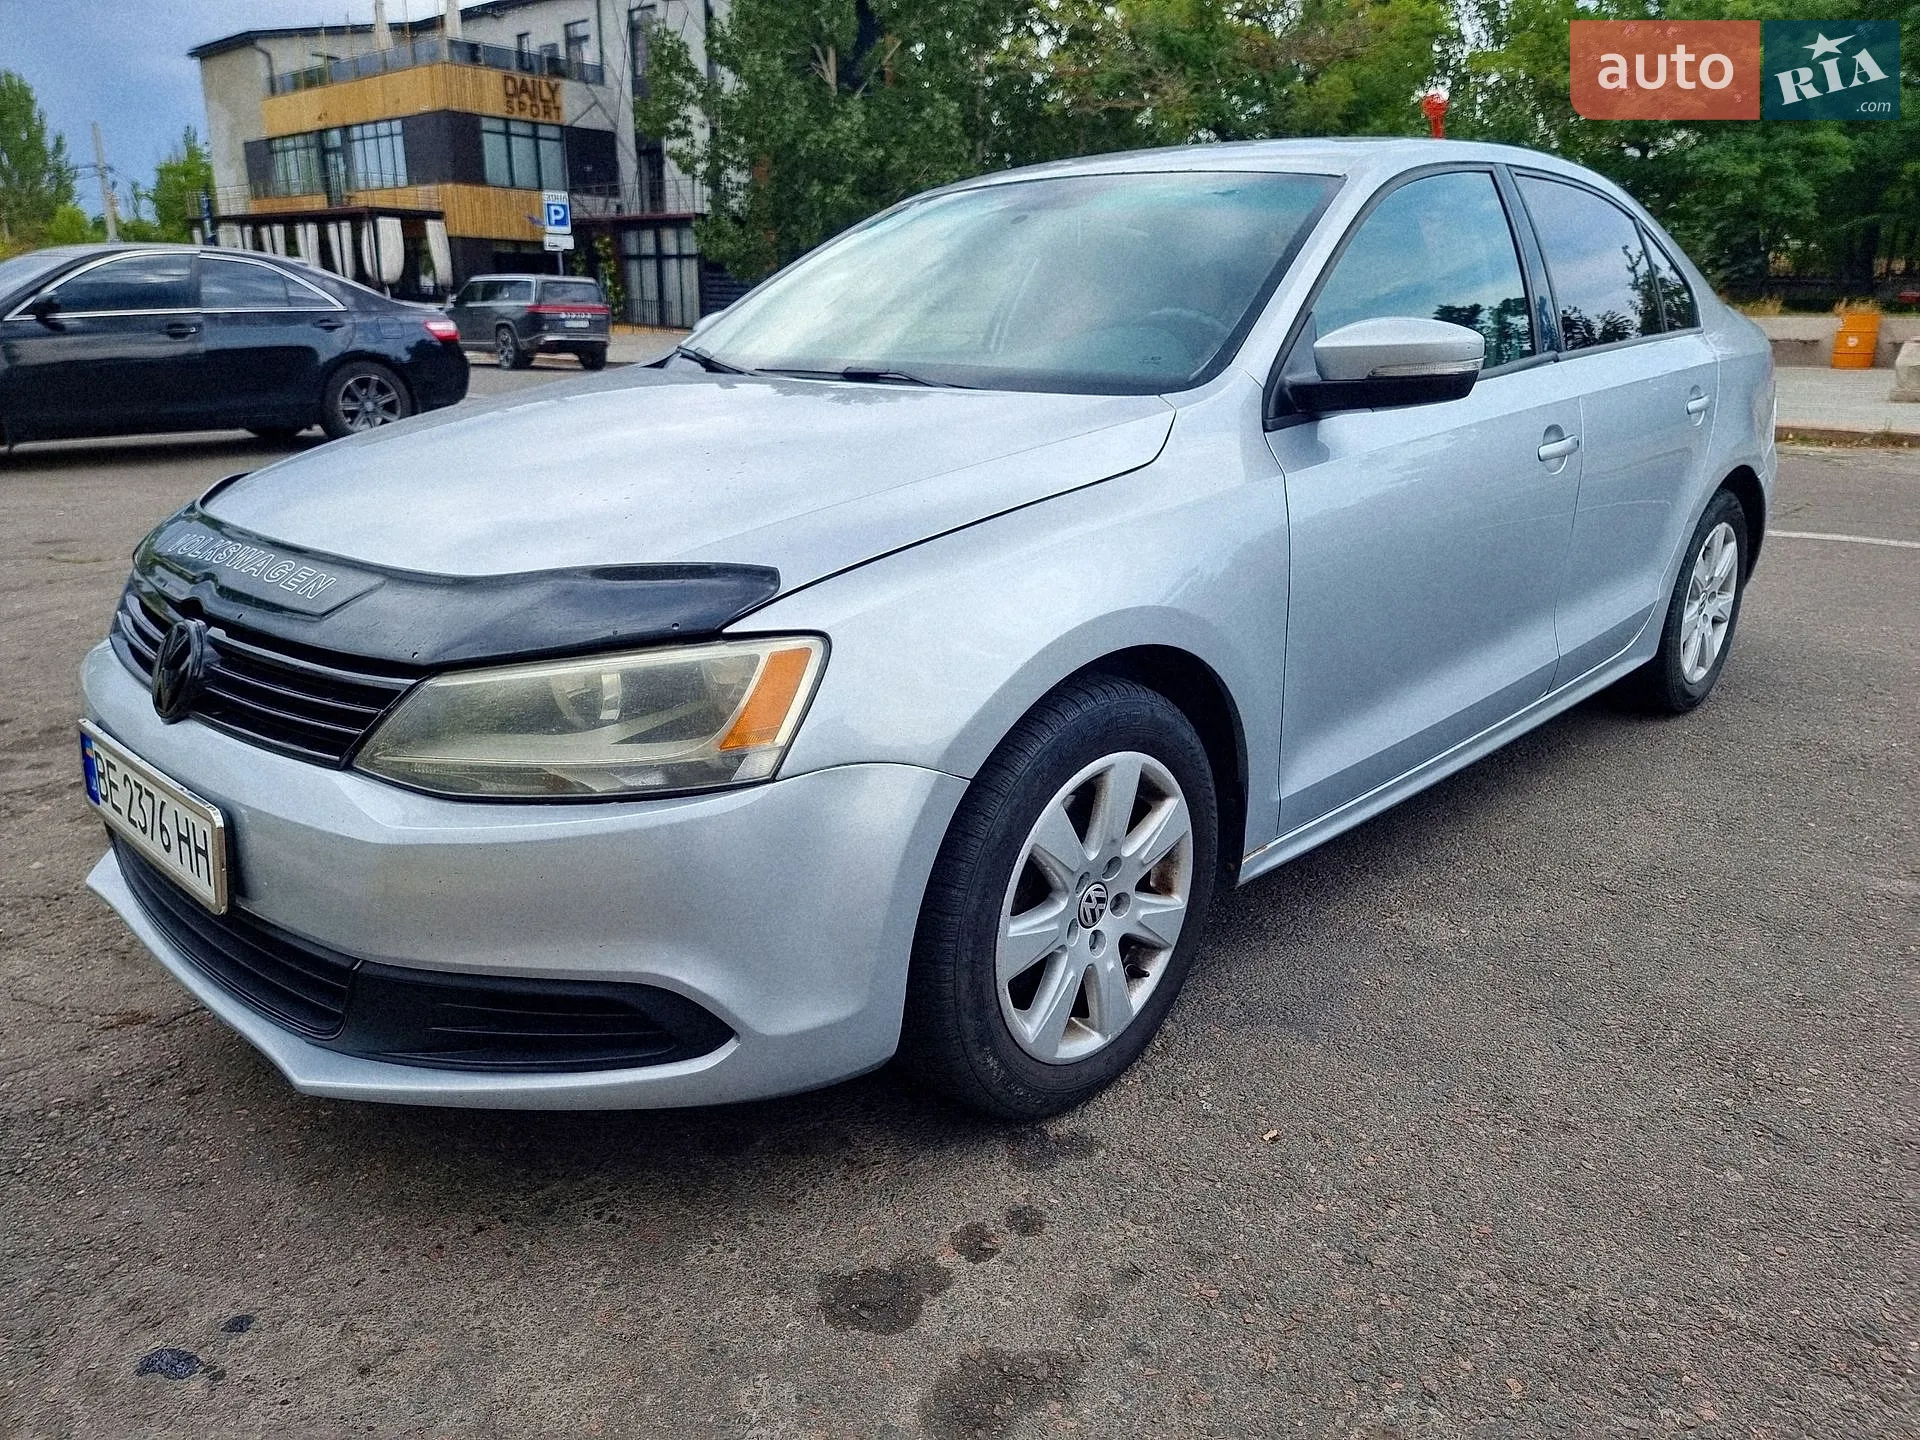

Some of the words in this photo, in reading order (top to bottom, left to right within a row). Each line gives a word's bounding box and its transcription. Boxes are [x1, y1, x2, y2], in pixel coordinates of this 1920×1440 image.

[503, 74, 561, 104] DAILY
[504, 100, 561, 121] SPORT
[168, 533, 336, 600] VOLKSWAGEN
[95, 749, 123, 816] BE
[123, 774, 172, 854] 2376
[174, 809, 212, 887] HH
